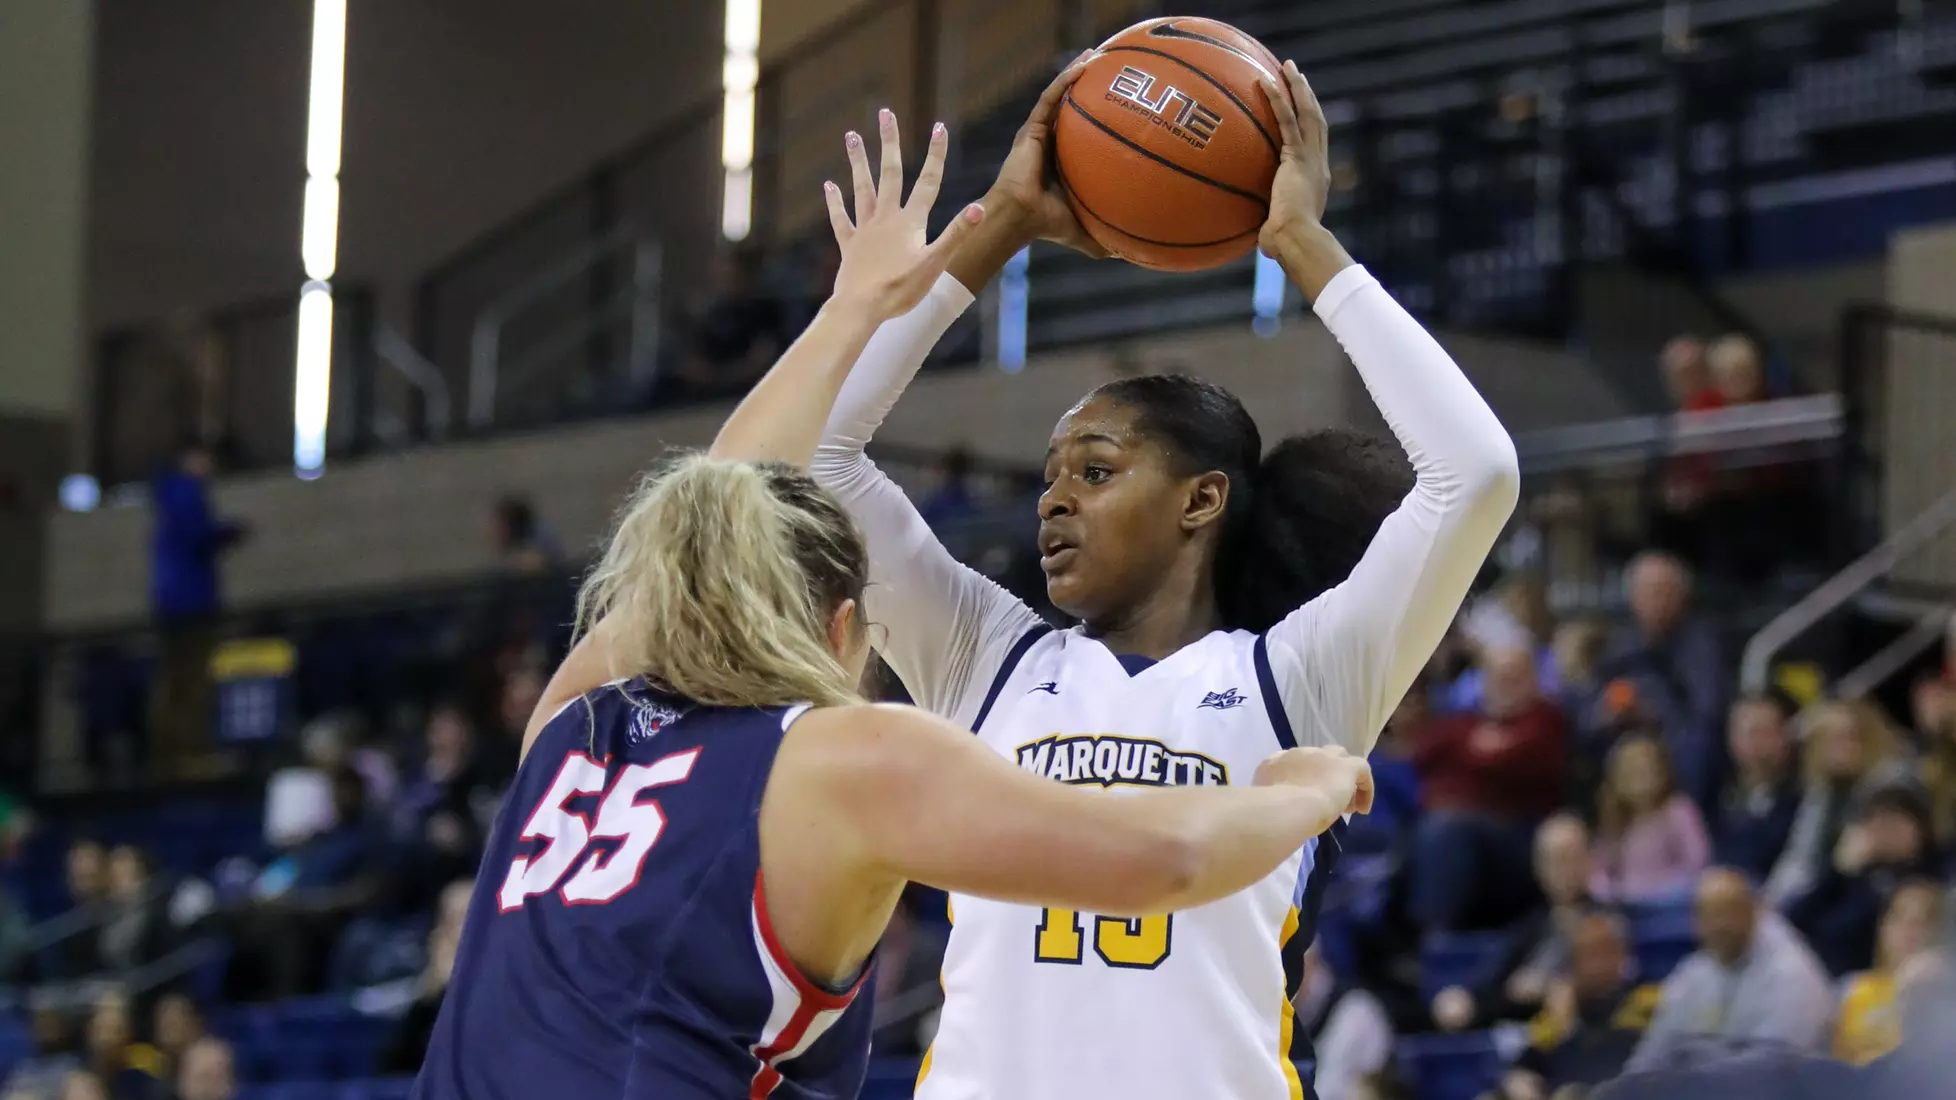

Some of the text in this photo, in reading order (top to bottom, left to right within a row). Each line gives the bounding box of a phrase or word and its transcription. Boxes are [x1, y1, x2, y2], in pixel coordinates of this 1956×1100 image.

[1104, 92, 1206, 151] CHAMPIONSHIP
[1109, 65, 1223, 144] ELITE
[1201, 696, 1248, 708] EAST
[1207, 687, 1238, 701] BIG
[1018, 736, 1226, 788] MARQUETTE
[496, 745, 703, 914] 55
